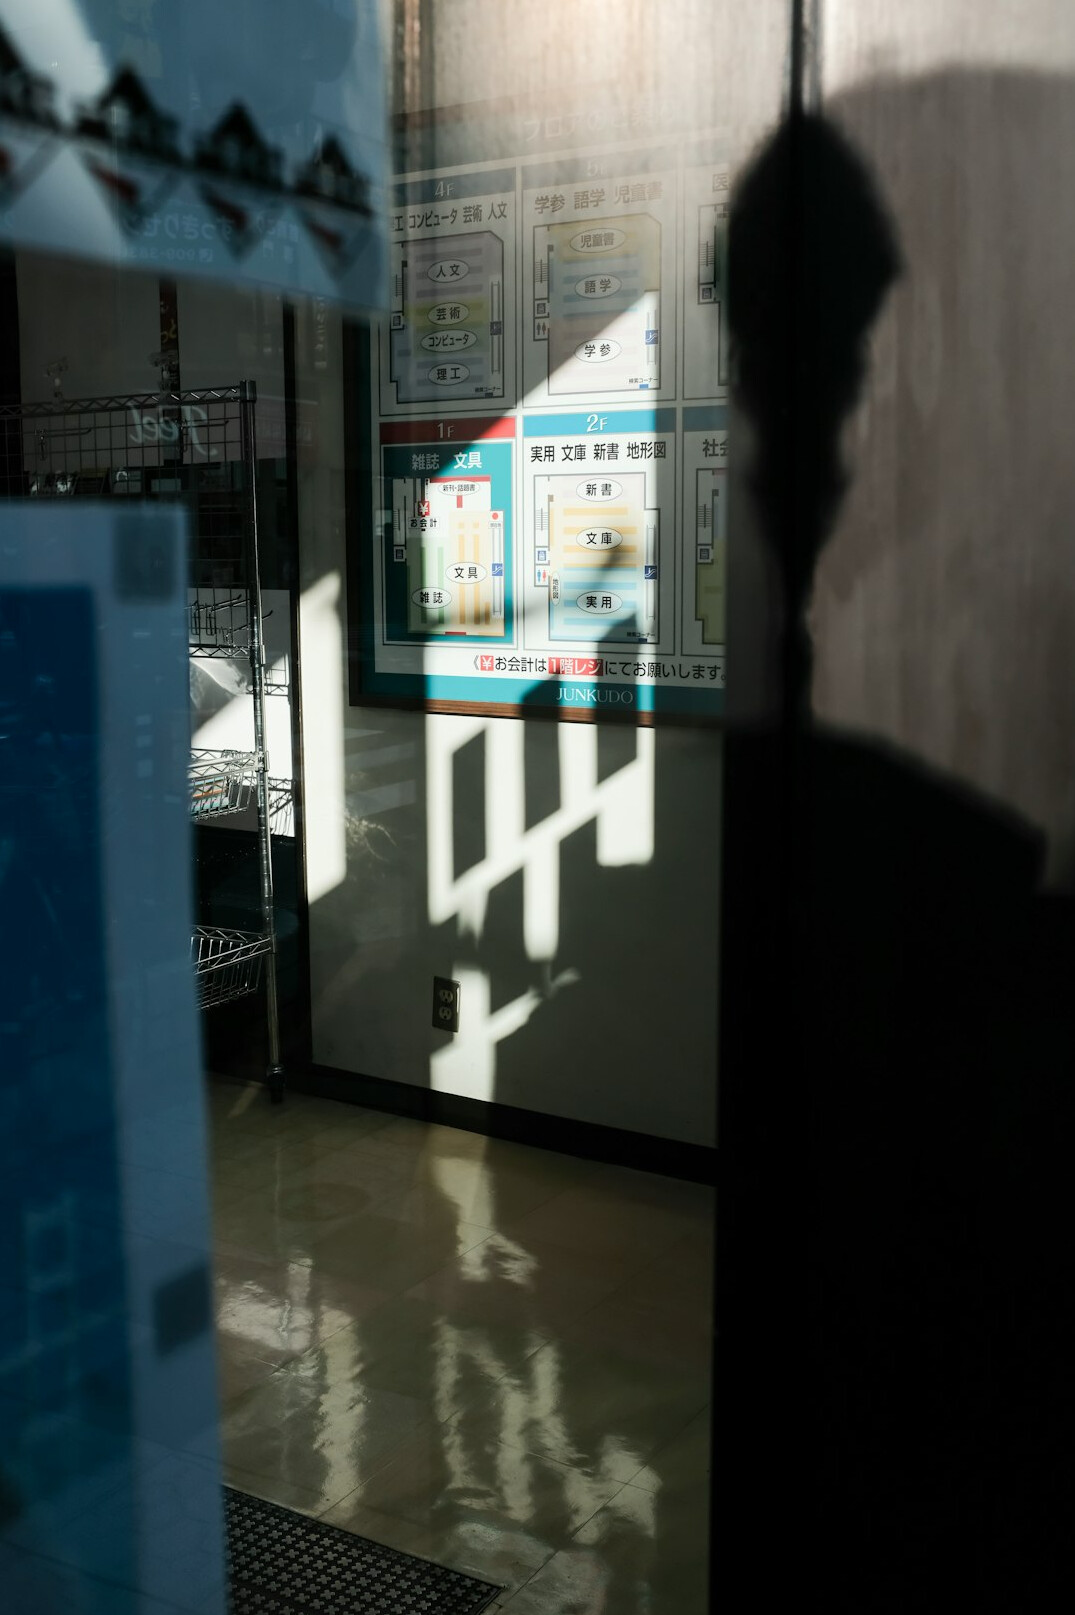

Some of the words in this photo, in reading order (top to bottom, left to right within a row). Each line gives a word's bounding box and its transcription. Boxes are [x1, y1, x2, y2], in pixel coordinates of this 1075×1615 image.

[434, 181, 455, 197] 4F
[534, 194, 565, 214] 学参
[574, 188, 605, 210] 語学
[614, 181, 663, 204] 児童書
[409, 208, 458, 229] コンピュータ
[463, 204, 482, 224] 芸術
[488, 201, 507, 220] 人文
[580, 233, 615, 249] 児童書
[436, 264, 460, 278] 人文
[584, 278, 611, 293] 語学
[436, 307, 460, 321] 芸術
[428, 334, 469, 347] コンピュータ
[584, 343, 611, 357] 学参
[436, 368, 460, 380] 理工
[586, 414, 608, 432] 2F
[437, 423, 455, 438] 1F
[530, 445, 555, 462] 実用
[561, 444, 586, 462] 文庫
[593, 443, 619, 461] 新書
[626, 441, 666, 459] 地形図
[412, 454, 439, 470] 雑誌
[454, 452, 482, 469] 文具
[586, 483, 612, 497] 新書
[411, 518, 437, 528] お会計
[586, 532, 612, 545] 文庫
[454, 567, 478, 579] 文具
[420, 591, 443, 604] 雑誌
[586, 596, 612, 609] 実用
[556, 687, 633, 704] JUNKUDO
